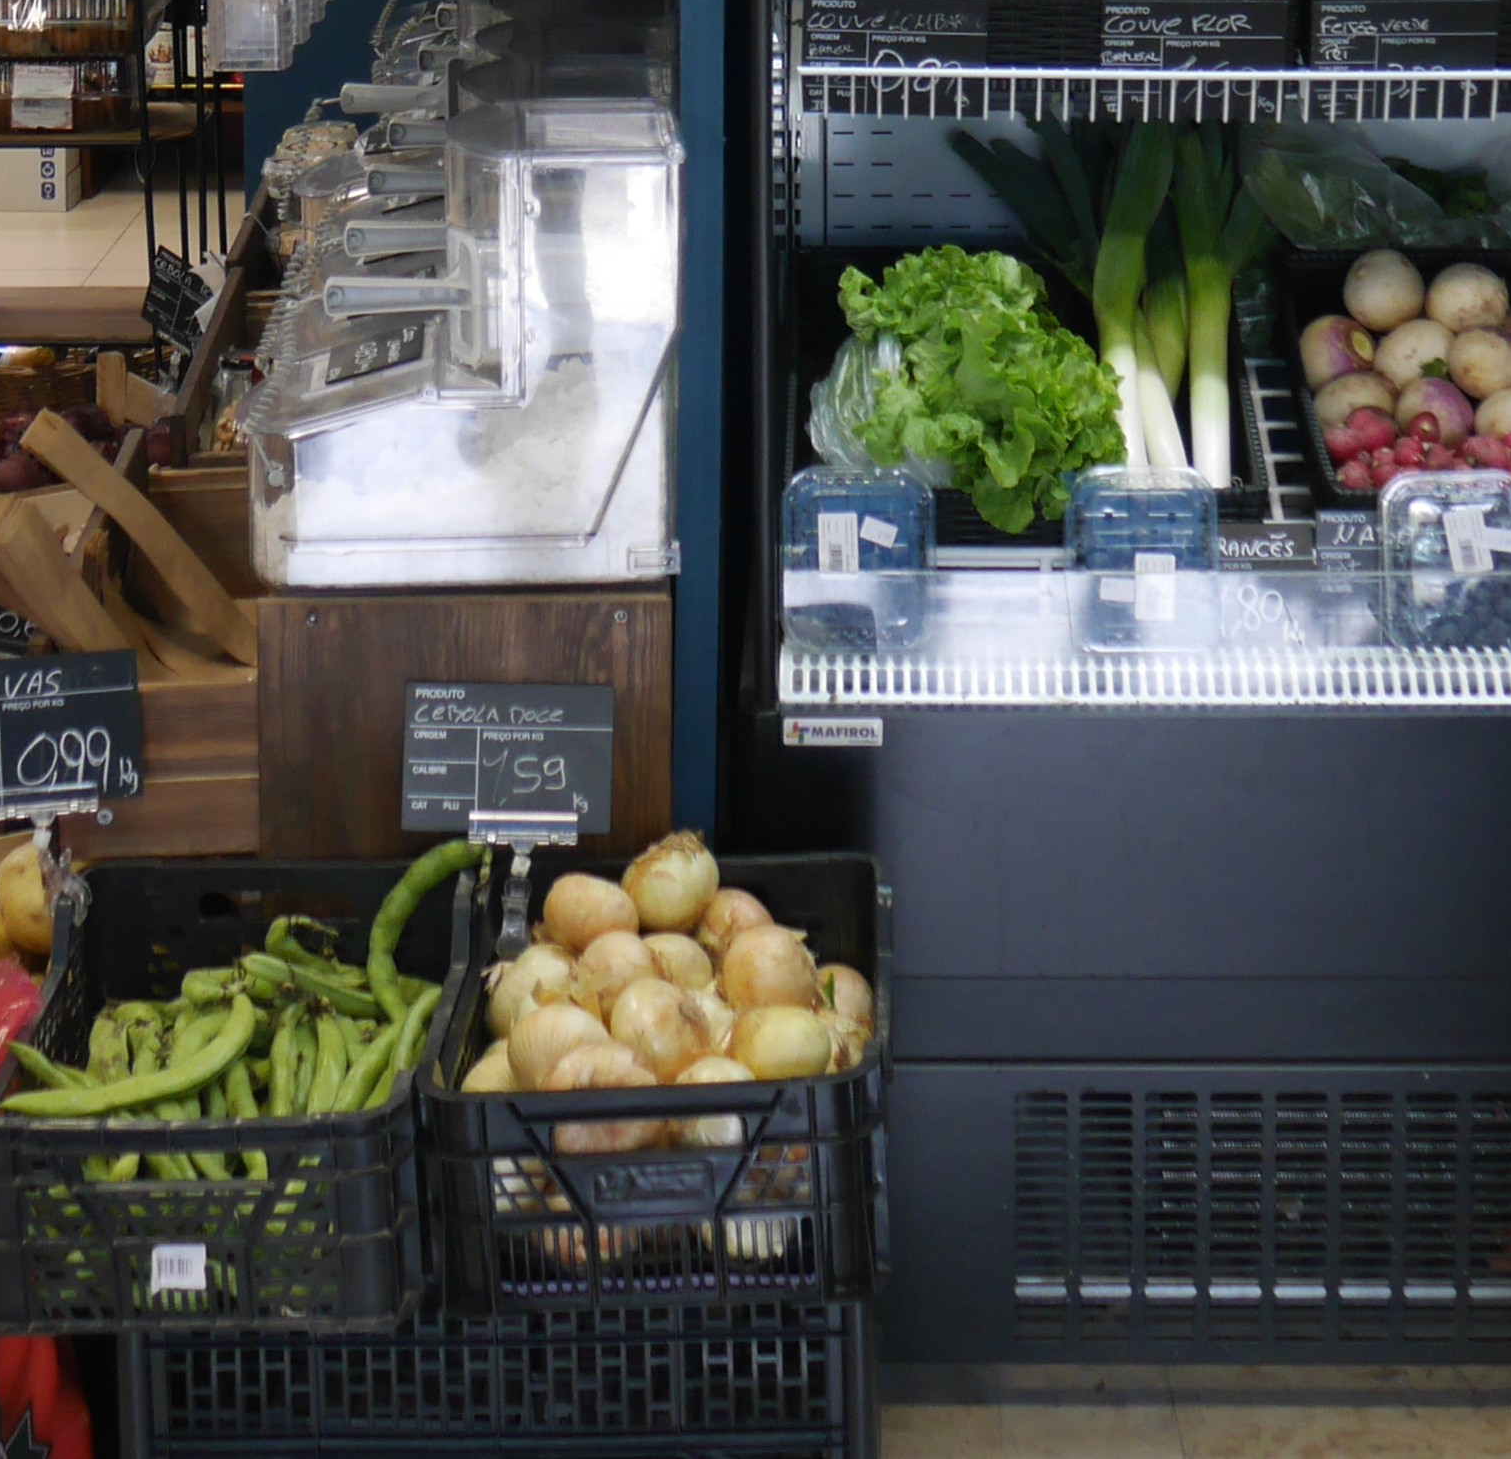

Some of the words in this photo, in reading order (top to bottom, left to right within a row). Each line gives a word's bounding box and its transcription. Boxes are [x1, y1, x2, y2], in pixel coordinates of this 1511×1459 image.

[811, 0, 856, 9] PRODUTO
[1321, 5, 1366, 14] PRODUTO
[1105, 6, 1150, 15] PRODUTO
[810, 33, 840, 42] ORIGEM
[1320, 513, 1366, 523] PRODUTO
[415, 688, 466, 700] PRODUTO
[2, 701, 31, 712] PREÇO
[32, 700, 51, 709] POR
[414, 730, 447, 740] ORIGEM
[483, 731, 512, 743] PREÇO
[513, 732, 531, 741] POR
[531, 732, 545, 742] KG
[810, 726, 879, 739] MAFIROL
[17, 725, 112, 793] 0,99
[412, 765, 447, 776] CALIBRE
[411, 801, 428, 811] CAT
[443, 801, 460, 811] PLU
